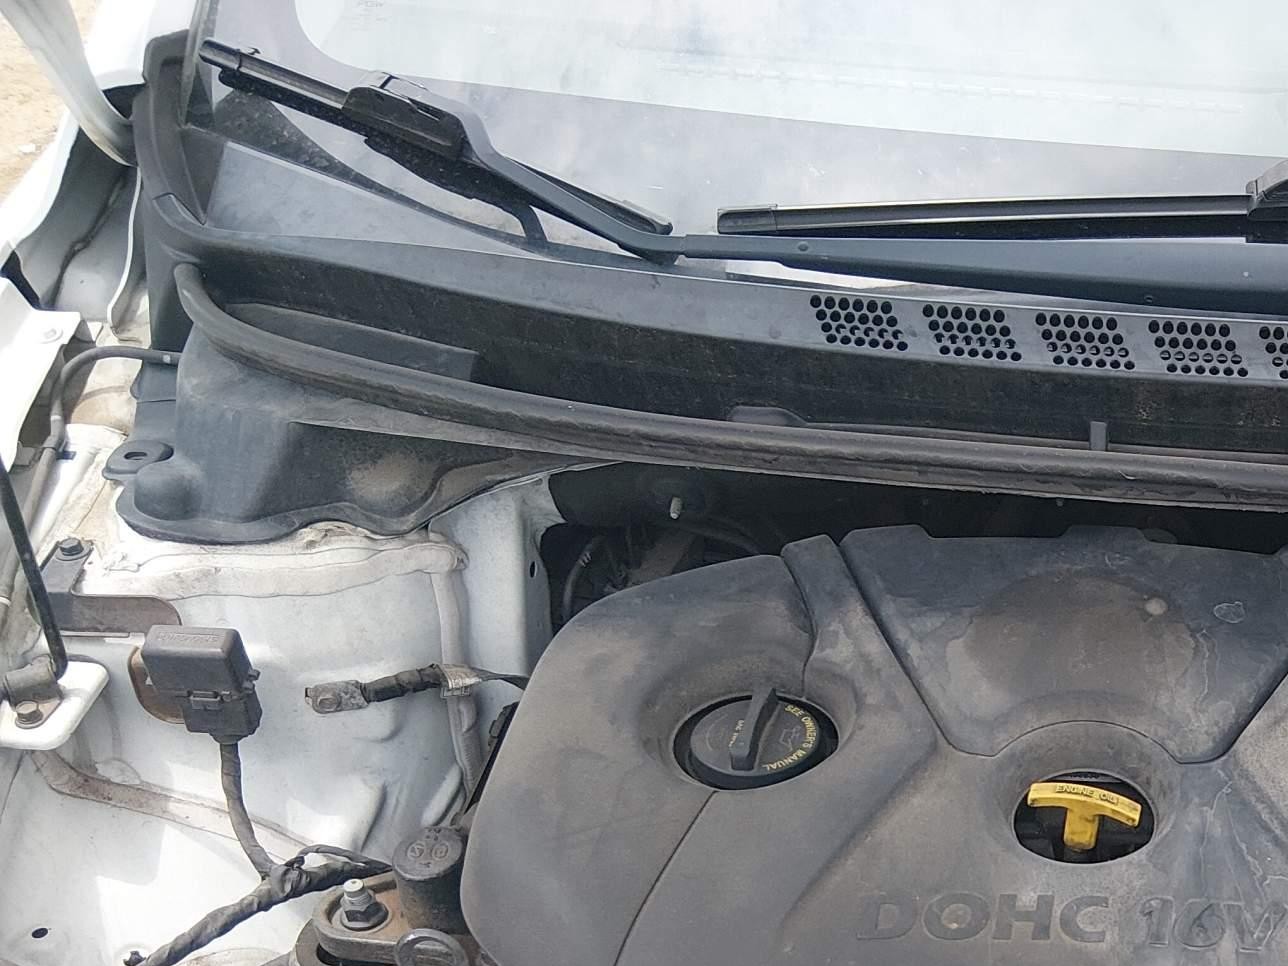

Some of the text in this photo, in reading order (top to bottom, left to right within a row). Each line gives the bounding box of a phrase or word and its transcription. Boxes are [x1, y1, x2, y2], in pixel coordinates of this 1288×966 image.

[761, 704, 817, 771] SEE OWNER'S MANUAL
[1055, 784, 1119, 805] ENGINE OIL
[855, 892, 1288, 953] DOHC 16V
